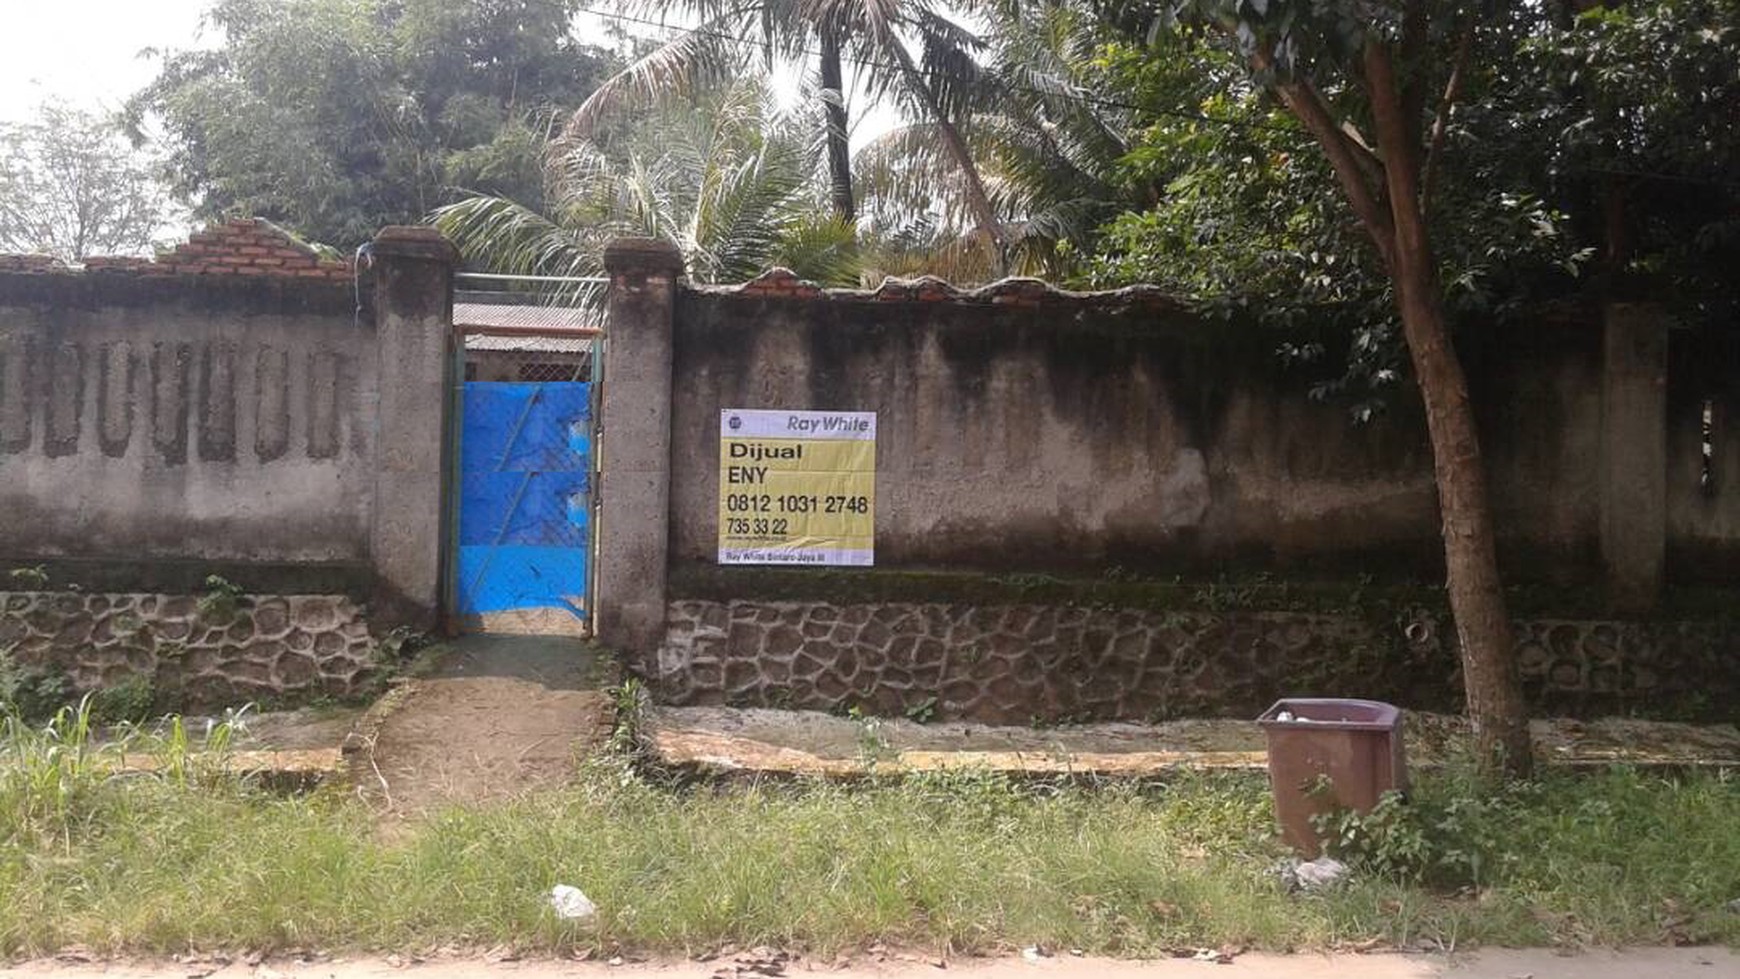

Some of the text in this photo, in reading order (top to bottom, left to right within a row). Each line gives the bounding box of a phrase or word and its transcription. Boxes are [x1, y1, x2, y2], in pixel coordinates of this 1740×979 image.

[787, 415, 869, 433] Ray White
[730, 443, 803, 461] Dijual
[728, 466, 768, 484] ENY
[727, 493, 869, 514] 0812 1031 2748
[727, 517, 788, 535] 735 33 22
